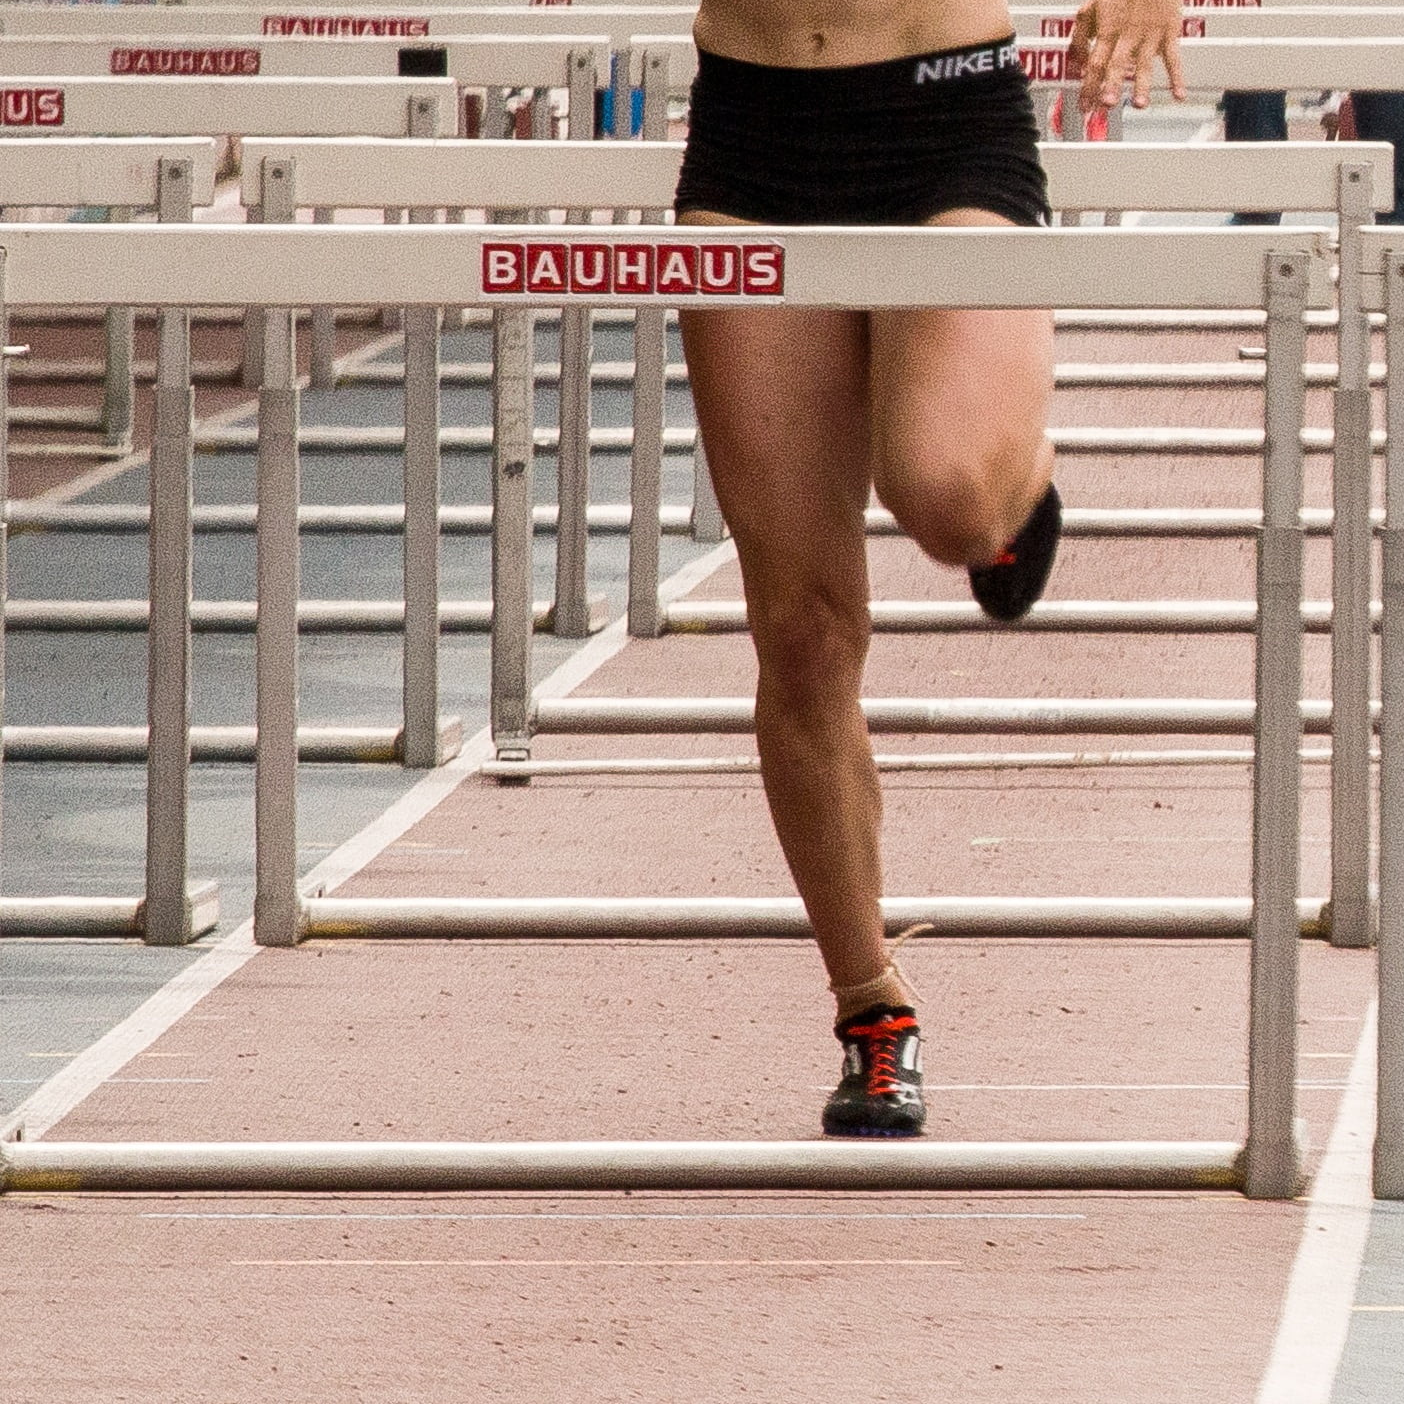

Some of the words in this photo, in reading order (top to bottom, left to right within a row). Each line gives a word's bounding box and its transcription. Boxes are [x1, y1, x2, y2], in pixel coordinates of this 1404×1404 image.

[111, 49, 260, 75] BAUHAUS
[915, 49, 995, 85] NIKE
[484, 245, 783, 293] BAUHAUS
